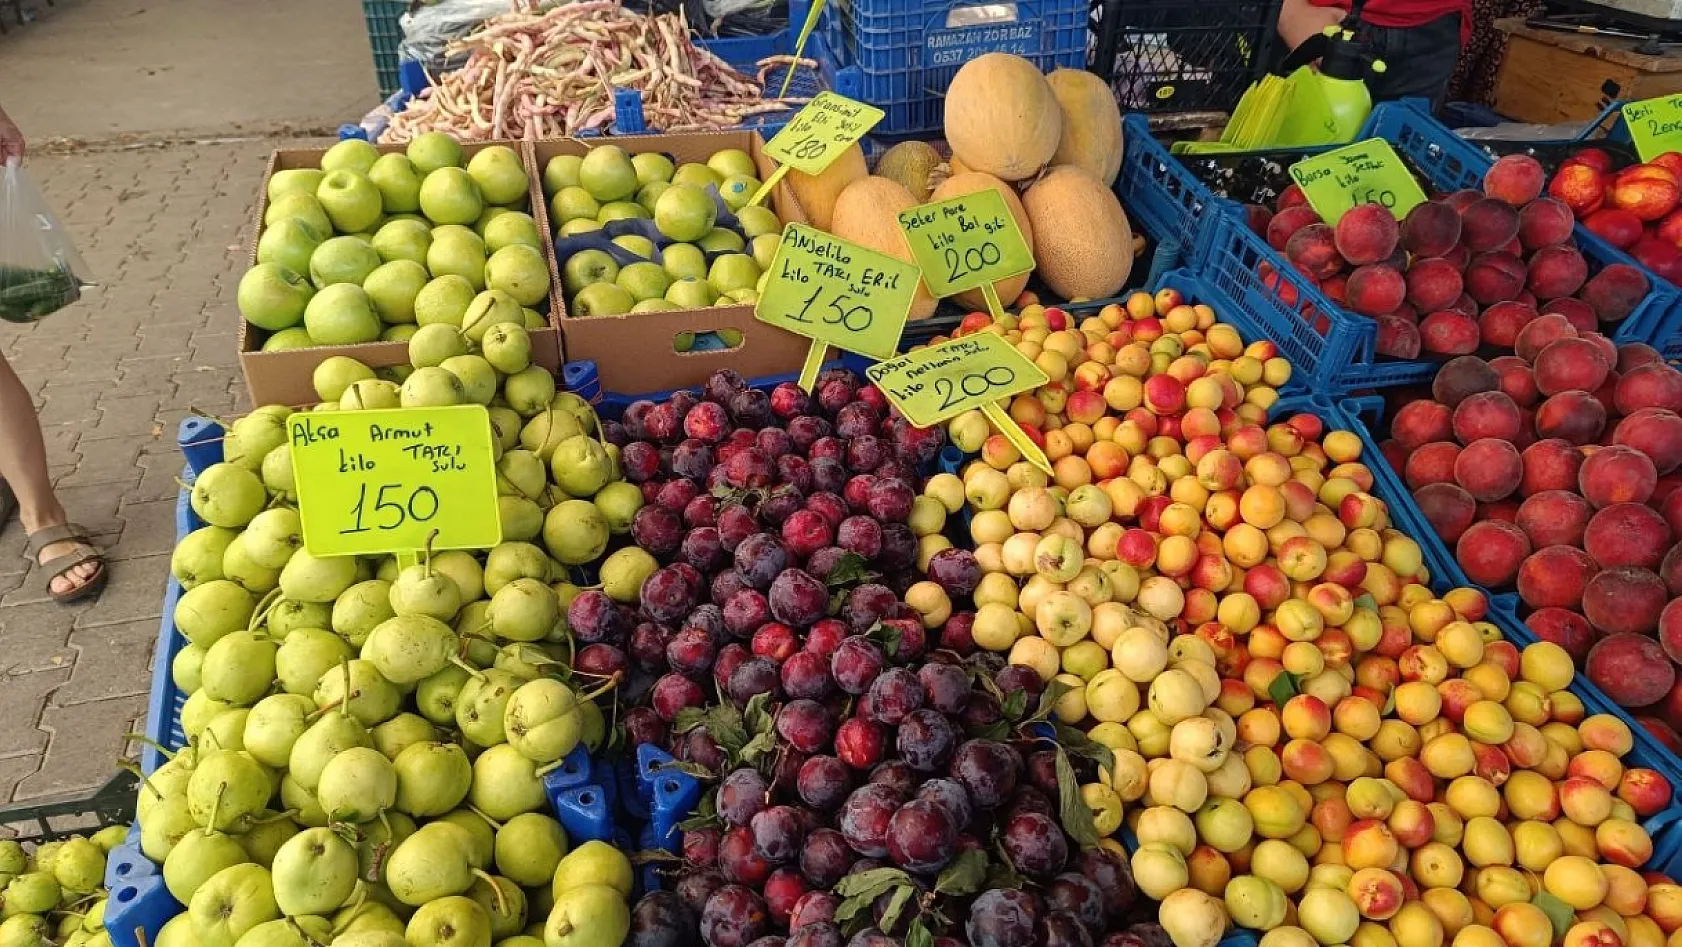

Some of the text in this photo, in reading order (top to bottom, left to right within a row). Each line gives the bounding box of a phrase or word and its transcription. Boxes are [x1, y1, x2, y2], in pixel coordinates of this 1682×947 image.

[927, 32, 982, 49] RAMAZAN
[933, 49, 963, 63] 0537
[780, 133, 827, 160] 180
[945, 242, 1001, 284] 200
[784, 285, 874, 332] 150
[933, 366, 1016, 412] 200
[369, 421, 434, 443] Armut
[339, 483, 439, 535] 150
